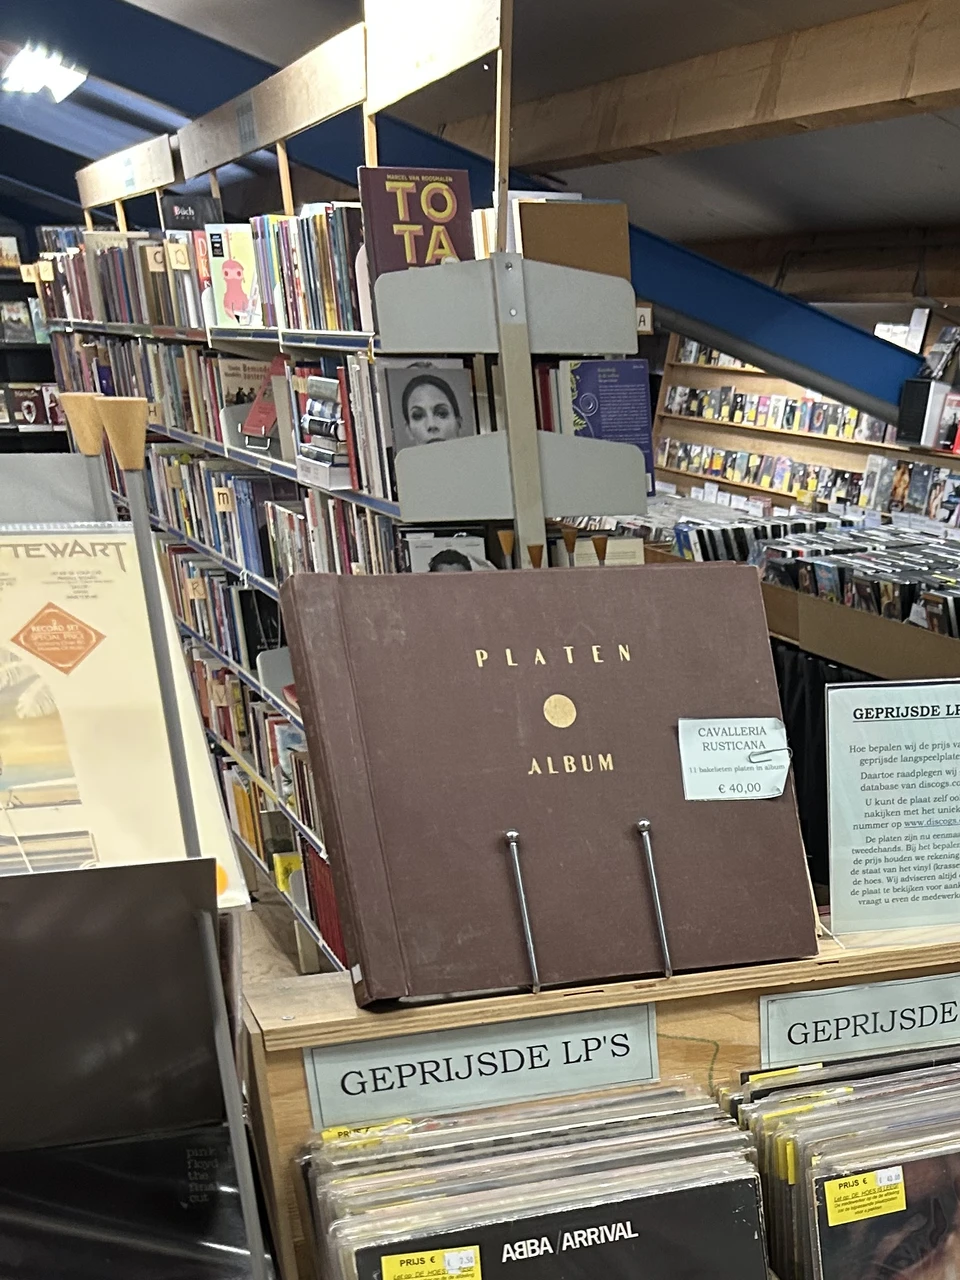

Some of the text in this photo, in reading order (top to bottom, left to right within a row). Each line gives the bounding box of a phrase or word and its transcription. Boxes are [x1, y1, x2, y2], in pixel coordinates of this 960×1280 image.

[386, 181, 457, 223] TO
[393, 224, 460, 264] TA
[638, 314, 646, 327] A
[0, 540, 127, 572] TEWART
[475, 644, 632, 667] PLATEN
[853, 705, 941, 720] GEPRIJSDE
[698, 726, 767, 737] CAVALLERIA
[702, 740, 766, 752] RUSTICANA
[849, 745, 866, 753] Hoe
[869, 744, 902, 754] bepalen
[905, 743, 916, 752] wij
[919, 742, 929, 750] de
[932, 741, 950, 751] prijs
[528, 753, 614, 775] ALBUM
[860, 756, 898, 766] geprijsde
[734, 764, 754, 773] platen
[764, 763, 785, 771] album
[861, 771, 894, 780] Daartoe
[897, 769, 942, 780] raadplegen
[945, 768, 957, 777] wij
[718, 782, 762, 795] € 40,00
[861, 783, 898, 792] database
[875, 798, 895, 806] kunt
[910, 796, 930, 806] plaat
[933, 794, 948, 802] zelf
[864, 809, 900, 819] nakijken
[904, 808, 919, 816] met
[922, 807, 935, 815] het
[853, 822, 888, 830] nummer
[891, 822, 902, 830] op
[878, 835, 902, 844] platen
[904, 834, 917, 842] zijn
[862, 887, 880, 896] plaat
[892, 885, 923, 894] bekijken
[858, 898, 882, 906] vraagt
[786, 1001, 960, 1048] GEPRIJSDE
[339, 1032, 632, 1098] GEPRIJSDE LP'S
[839, 1179, 859, 1190] PRIJS
[501, 1220, 639, 1264] ABBA ARRIVAL
[400, 1257, 425, 1267] PRIJS
